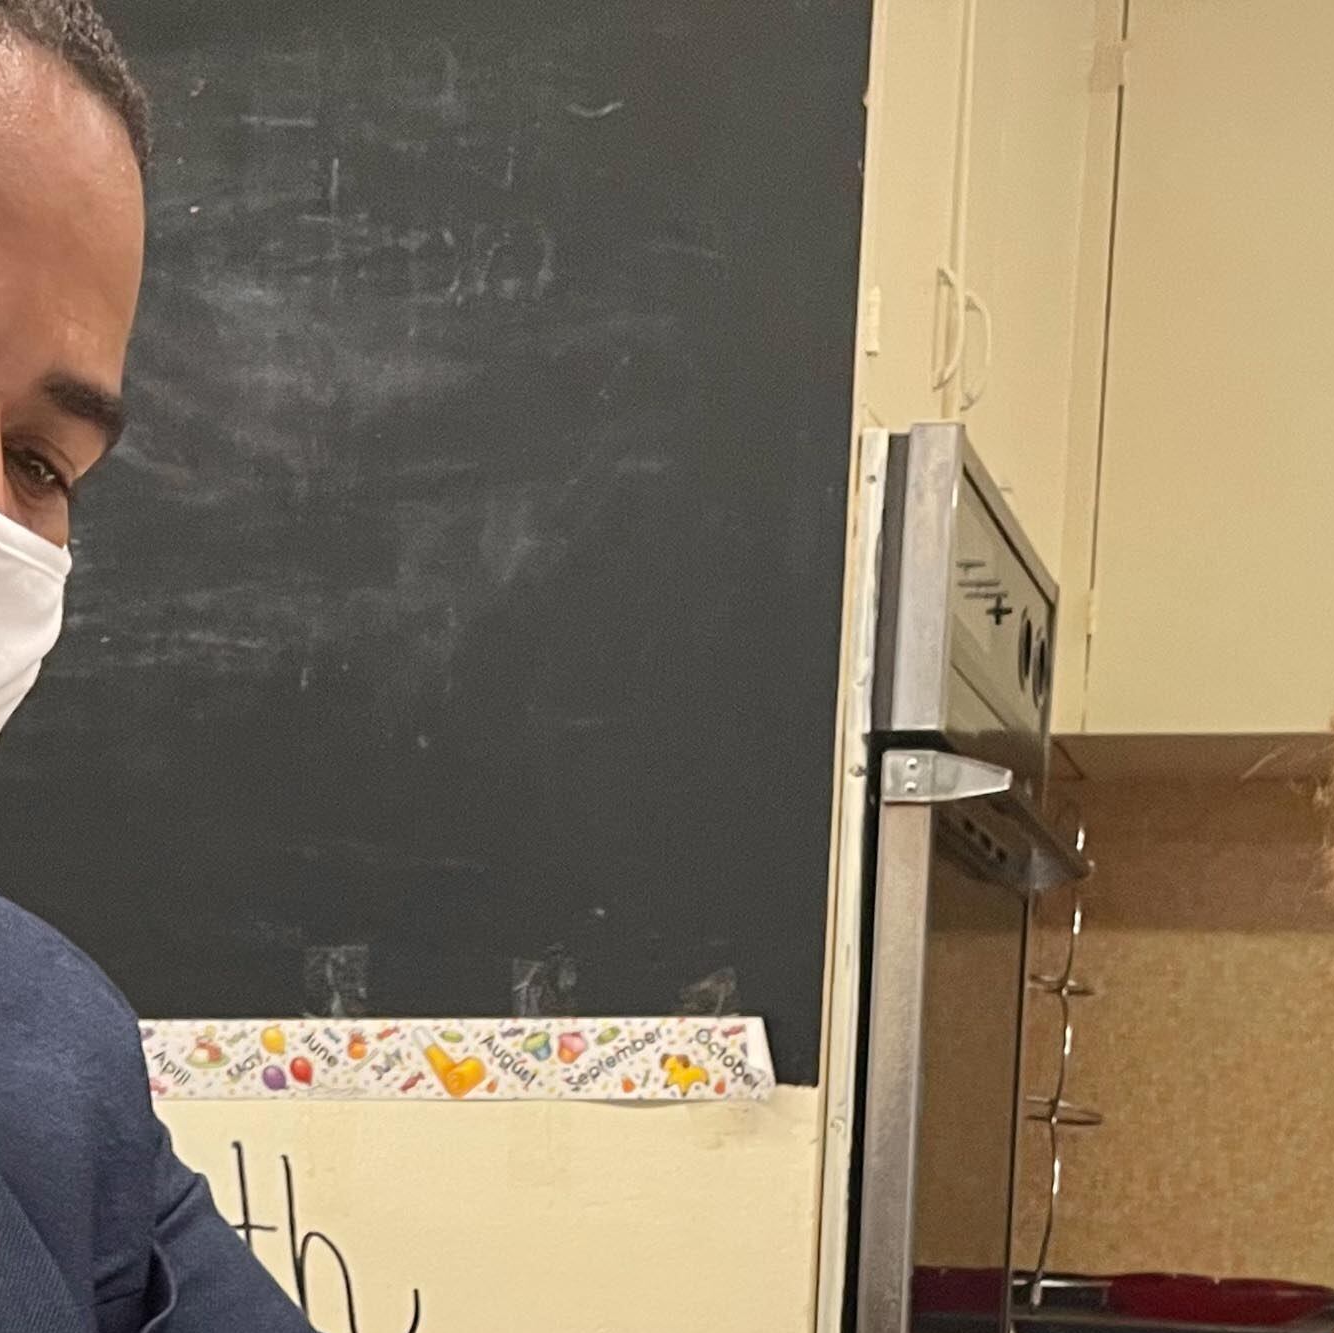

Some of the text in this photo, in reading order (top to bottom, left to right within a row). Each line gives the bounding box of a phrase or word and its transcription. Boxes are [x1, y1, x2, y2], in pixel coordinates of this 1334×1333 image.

[153, 1050, 191, 1085] April
[301, 1031, 339, 1067] June
[480, 1034, 537, 1086] August
[567, 1027, 663, 1092] September
[695, 1027, 759, 1089] October
